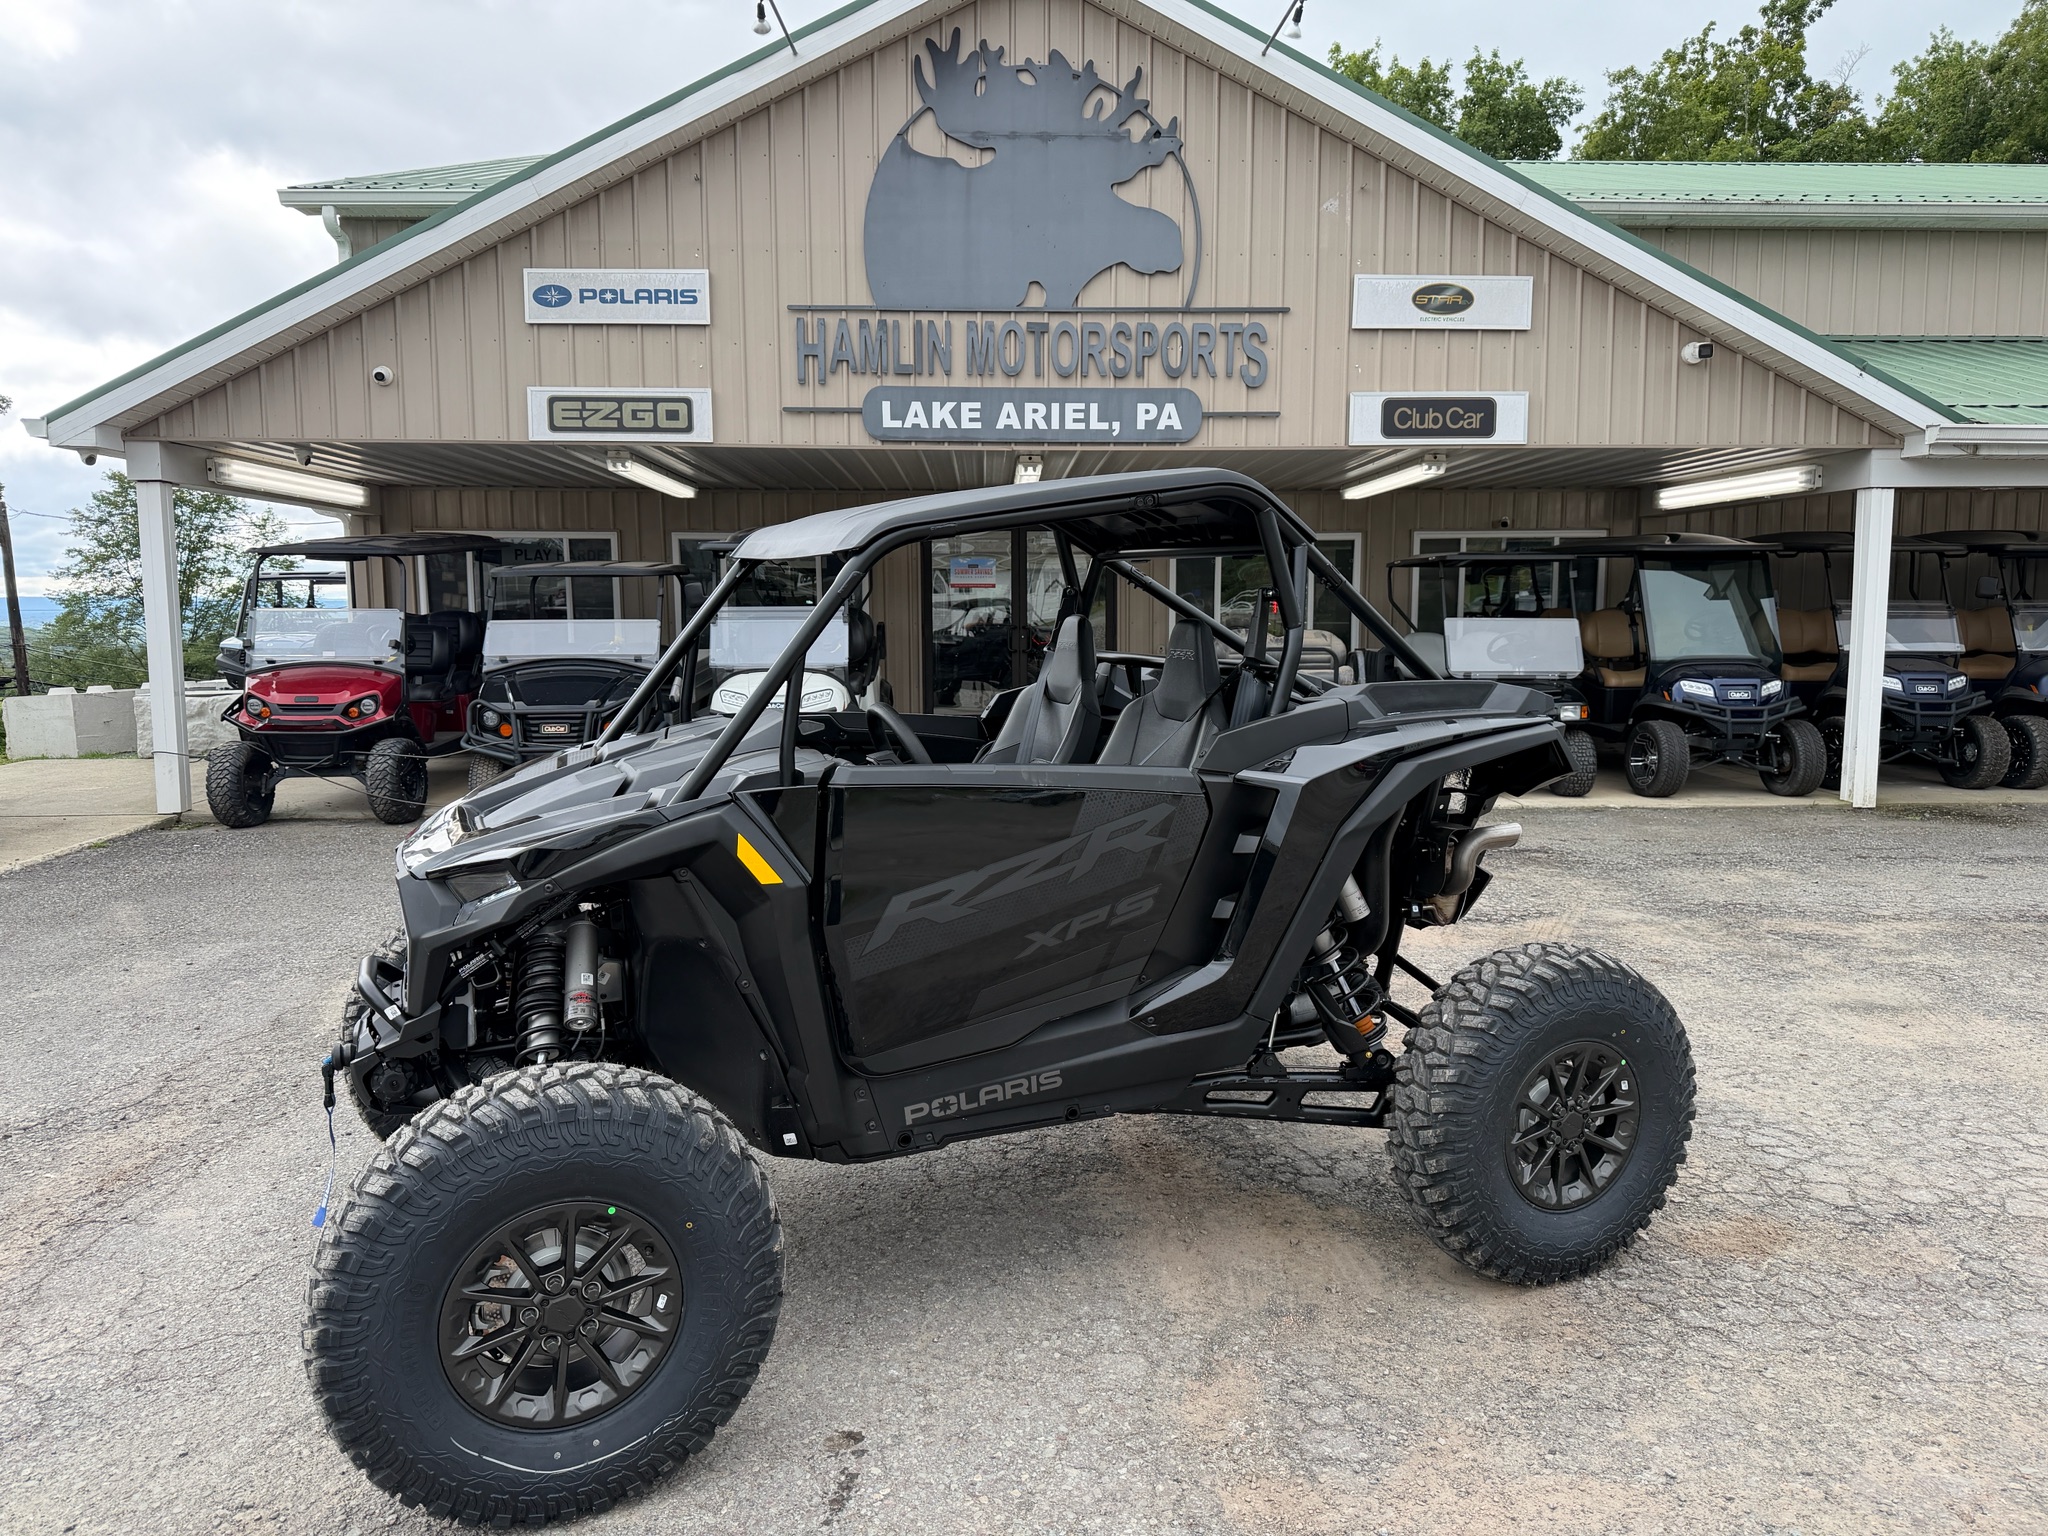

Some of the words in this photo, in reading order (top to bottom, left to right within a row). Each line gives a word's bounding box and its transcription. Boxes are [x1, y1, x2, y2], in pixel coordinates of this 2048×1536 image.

[579, 288, 699, 305] POLARIS
[796, 317, 951, 385] HAMLIN
[966, 320, 1268, 388] MOTORSPORTS
[553, 401, 688, 428] EZGO
[881, 401, 982, 428] LAKE
[995, 402, 1121, 436] ARIEL,
[1136, 403, 1183, 430] PA
[1393, 407, 1443, 429] Club
[1446, 407, 1484, 429] Car
[514, 549, 552, 561] PLAY
[556, 549, 612, 561] HARDE
[859, 801, 1178, 958] RZR
[903, 1070, 1063, 1126] POLARIS
